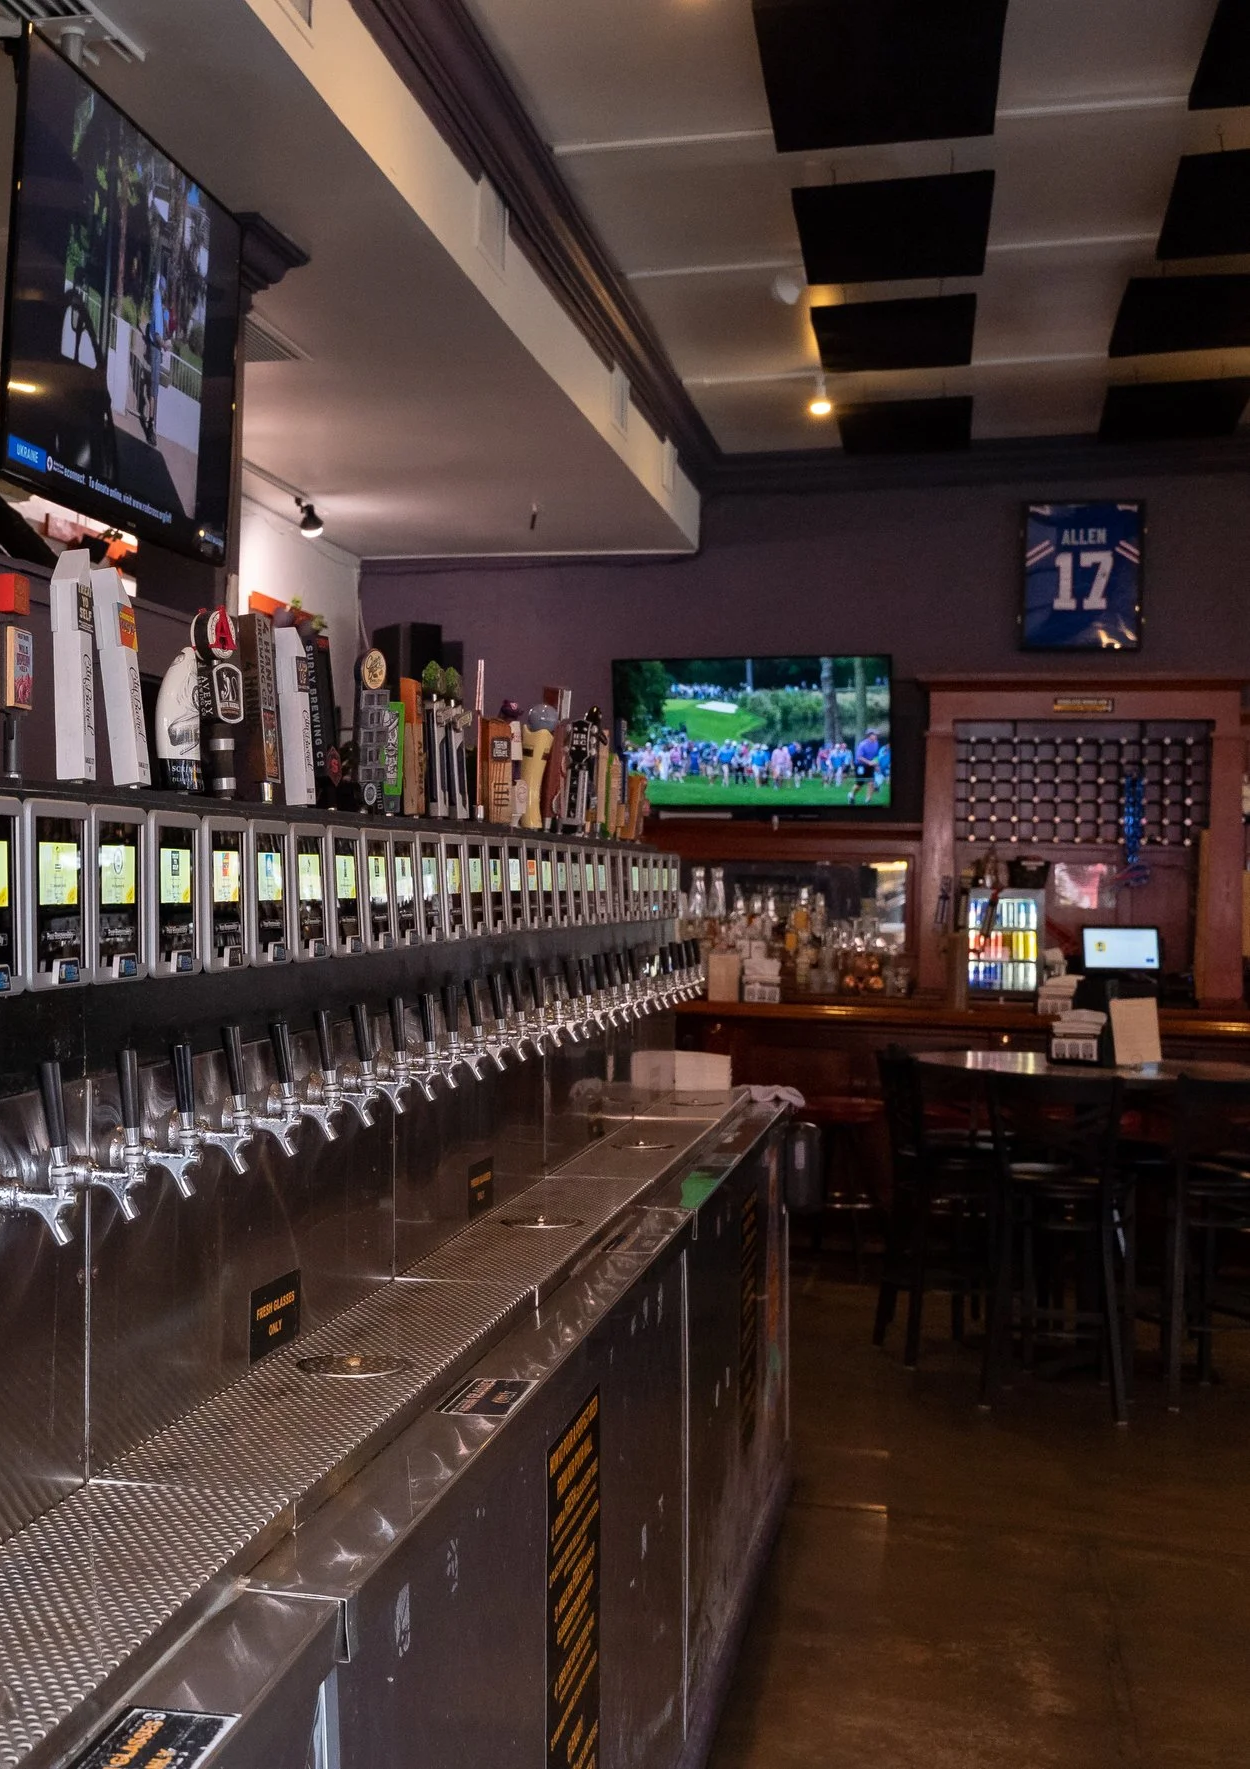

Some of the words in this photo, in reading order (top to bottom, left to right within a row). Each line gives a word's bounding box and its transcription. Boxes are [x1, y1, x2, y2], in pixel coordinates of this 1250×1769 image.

[16, 444, 39, 464] UKRAINE
[1061, 528, 1107, 546] ALLEN
[1053, 551, 1114, 610] 17
[79, 607, 92, 622] SELF
[264, 640, 275, 709] HANDS
[305, 644, 316, 684] SURLY
[202, 676, 214, 714] AVERY
[309, 688, 322, 746] BREWING
[256, 1302, 273, 1321] FRESH
[273, 1290, 295, 1312] GLASSES
[268, 1318, 282, 1336] ONLY
